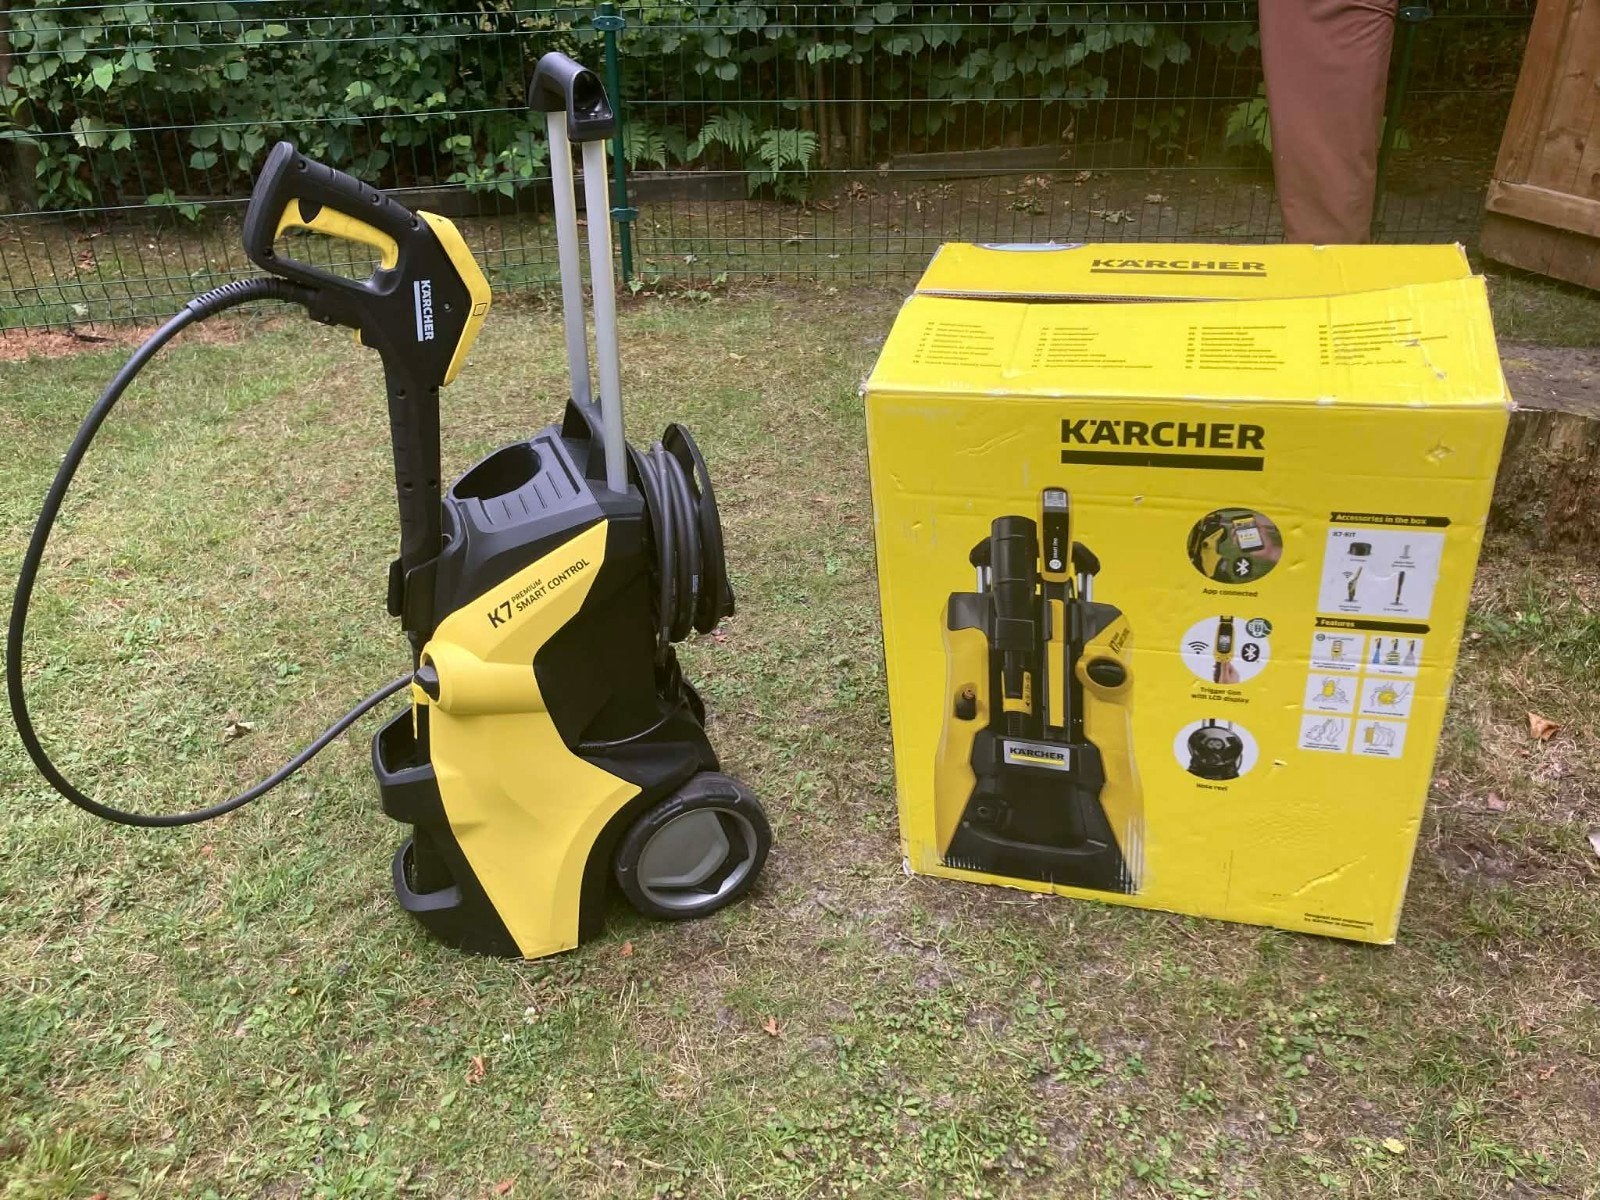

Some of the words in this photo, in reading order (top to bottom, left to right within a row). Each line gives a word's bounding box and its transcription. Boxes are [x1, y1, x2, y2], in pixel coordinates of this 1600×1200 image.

[1091, 259, 1266, 270] KÄRCHER
[420, 280, 435, 340] KÄRCHER
[1061, 418, 1265, 450] KÄRCHER
[1335, 514, 1383, 523] Accessories
[1394, 517, 1409, 525] the
[511, 578, 542, 603] PREMIUM
[516, 586, 547, 612] SMART
[547, 558, 590, 590] CONTROL
[487, 600, 513, 629] K7
[1320, 619, 1355, 628] Features
[1010, 747, 1065, 760] KÄRCHER
